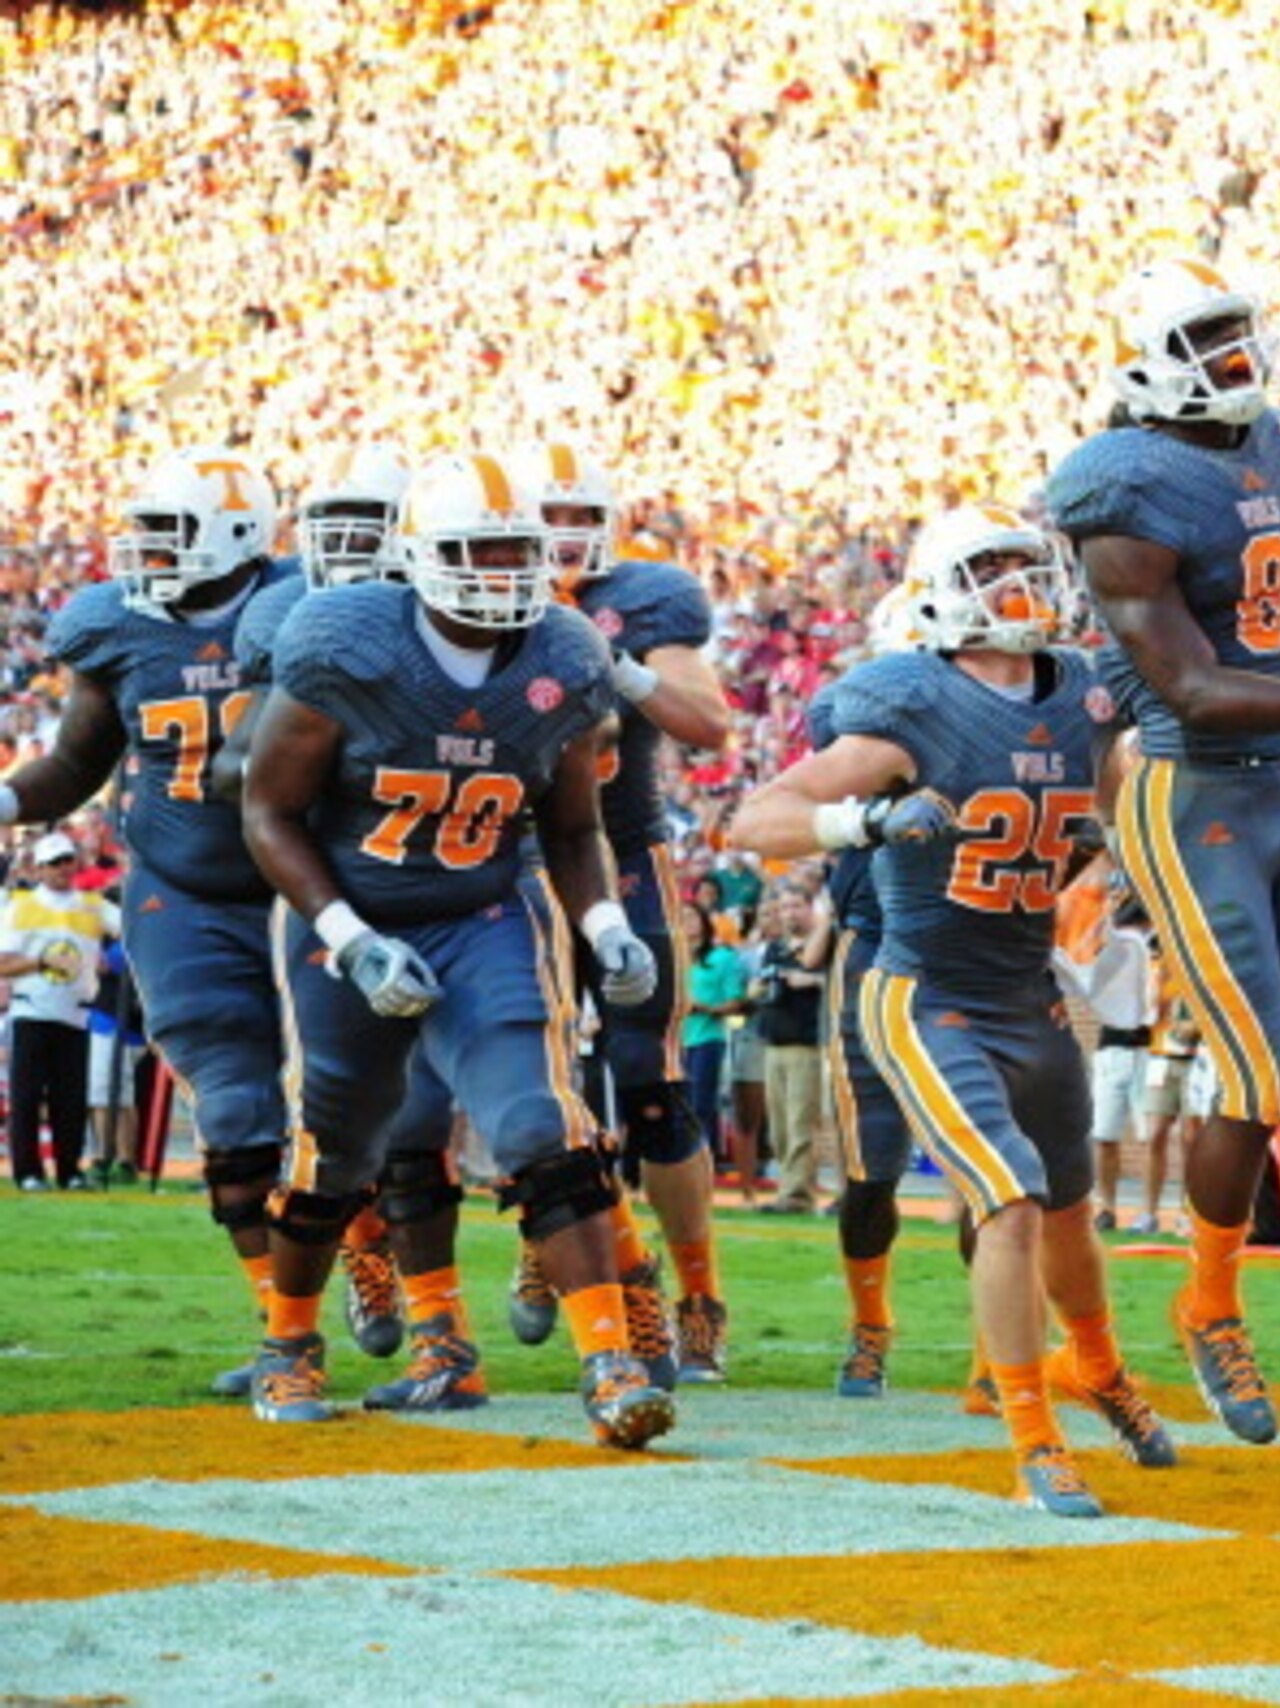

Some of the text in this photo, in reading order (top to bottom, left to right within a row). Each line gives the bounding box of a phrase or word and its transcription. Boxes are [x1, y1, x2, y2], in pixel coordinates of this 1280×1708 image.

[195, 461, 252, 511] T
[138, 695, 256, 803] 7
[359, 766, 525, 869] 70
[946, 786, 1098, 913] 25
